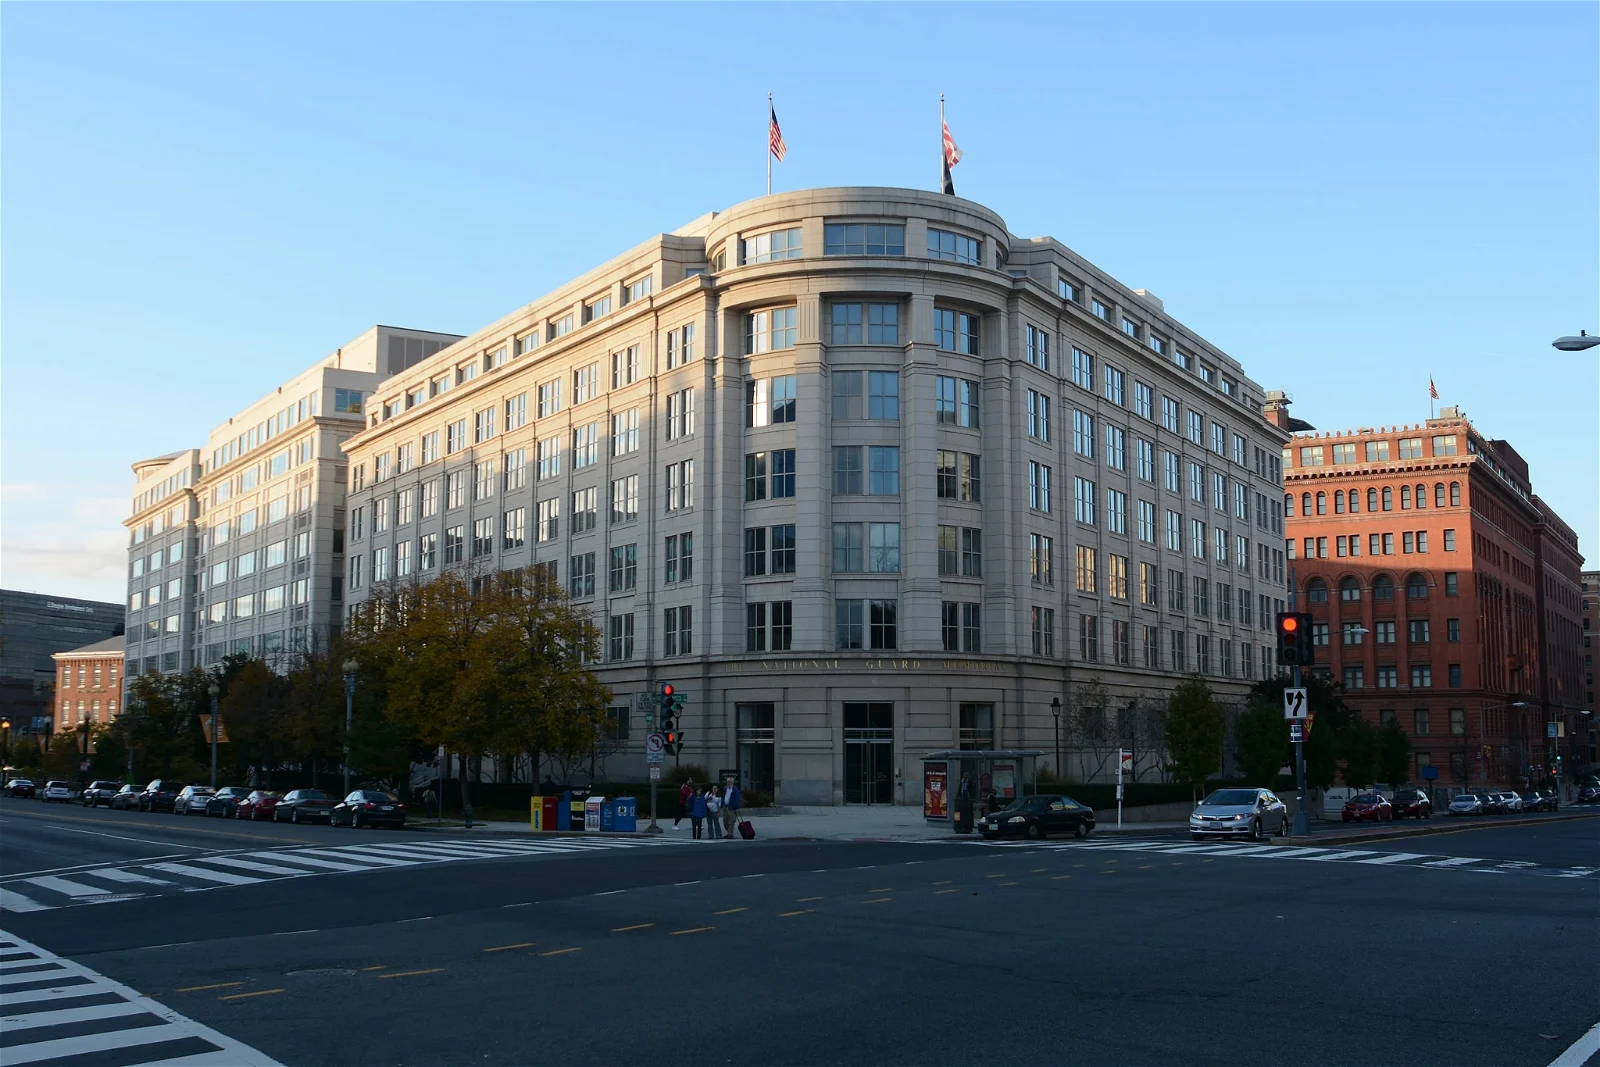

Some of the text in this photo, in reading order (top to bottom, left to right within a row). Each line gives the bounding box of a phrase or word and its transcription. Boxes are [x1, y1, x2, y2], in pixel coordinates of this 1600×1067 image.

[762, 660, 841, 670] NATIONAL
[866, 659, 920, 669] GUARD
[942, 660, 1006, 672] MEMORIAL
